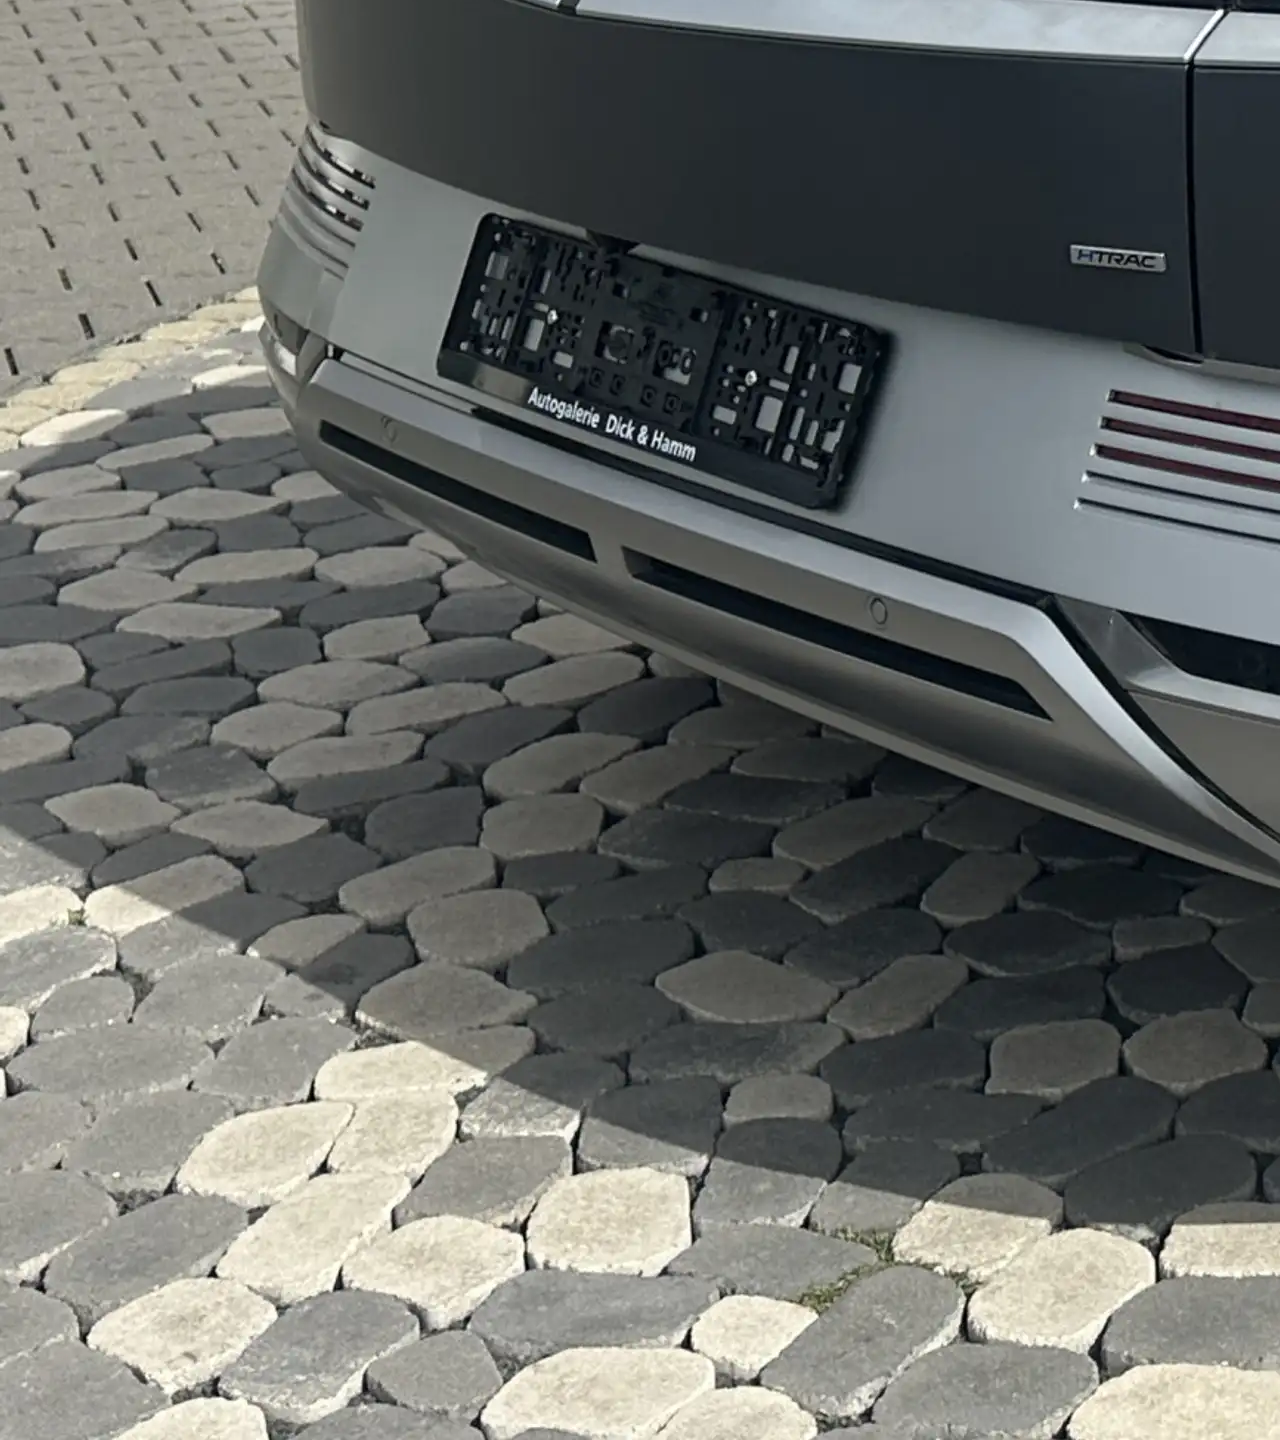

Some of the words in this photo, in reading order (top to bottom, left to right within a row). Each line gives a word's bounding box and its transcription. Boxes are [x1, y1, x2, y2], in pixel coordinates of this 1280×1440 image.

[1077, 249, 1157, 269] HTRAC
[528, 386, 600, 429] Autogalerie
[605, 414, 634, 441] Dick
[636, 424, 649, 446] &
[651, 429, 697, 462] Hamm
